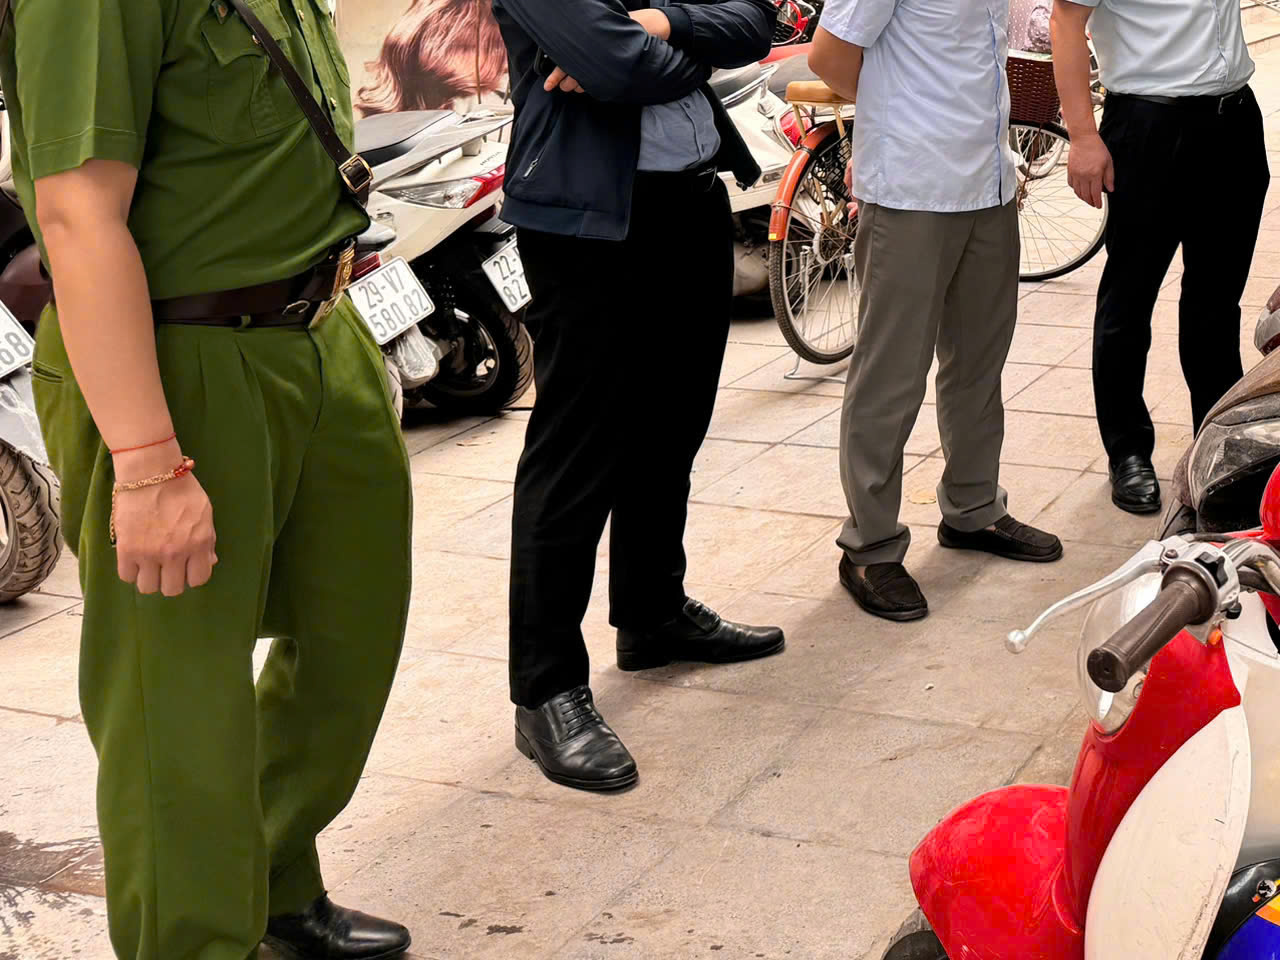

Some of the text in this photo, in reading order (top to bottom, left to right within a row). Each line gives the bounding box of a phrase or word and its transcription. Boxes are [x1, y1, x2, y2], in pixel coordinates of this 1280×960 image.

[493, 246, 520, 281] 22-
[358, 266, 405, 310] 29-V7
[502, 271, 528, 307] 82
[368, 288, 430, 338] 580.82
